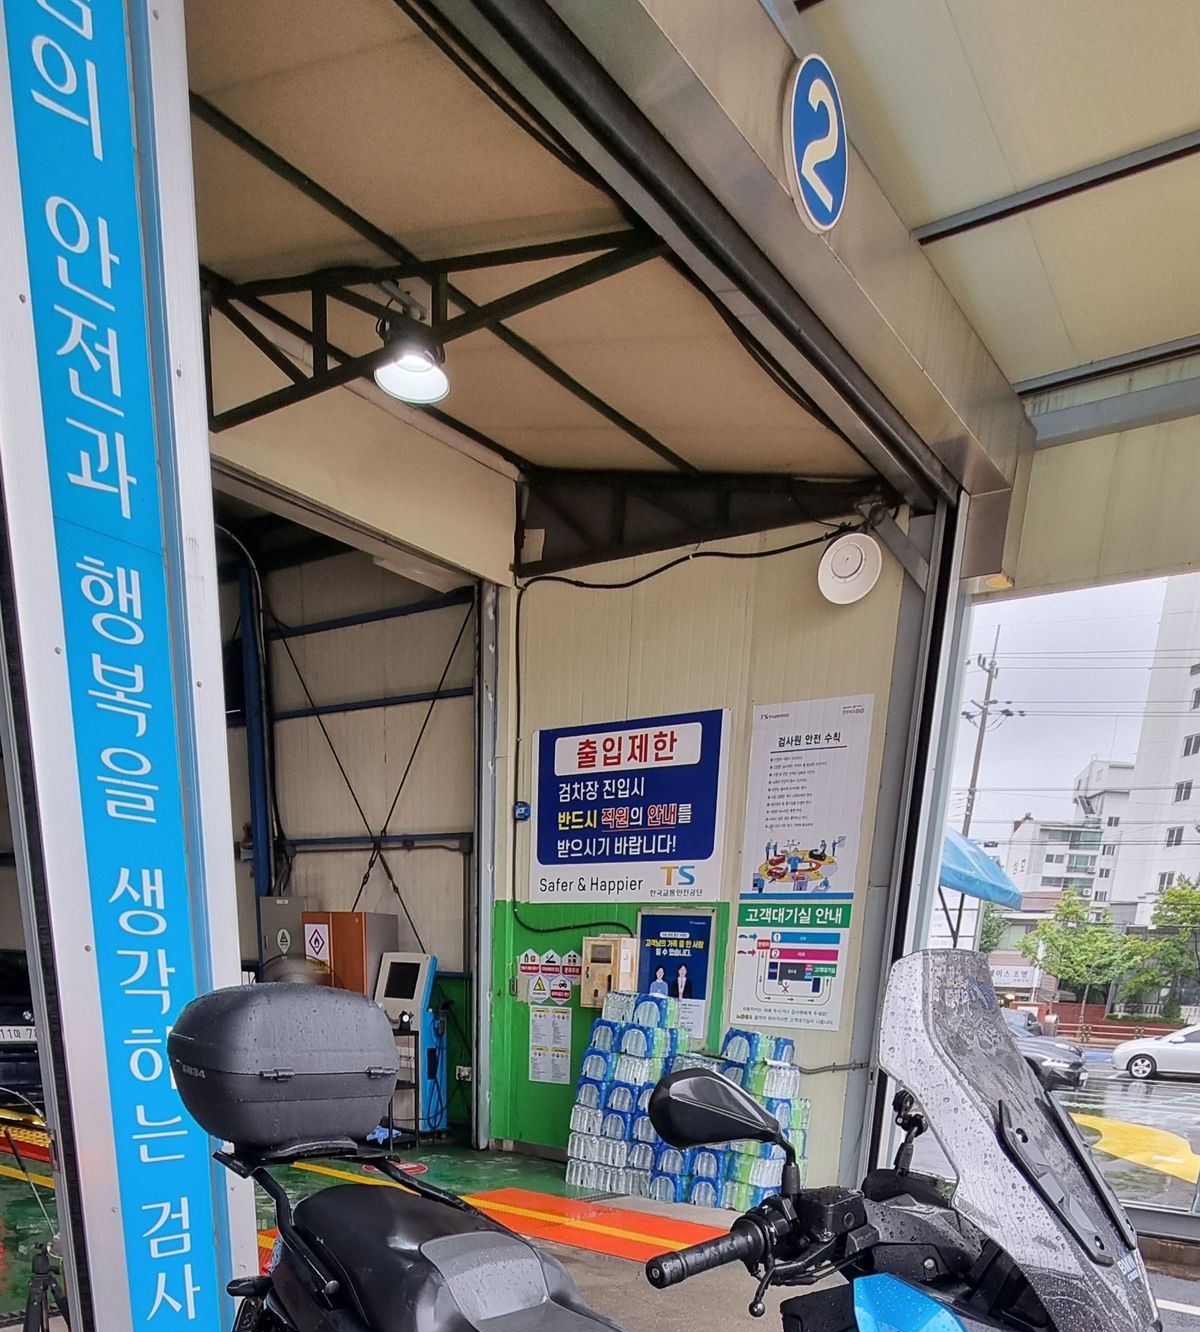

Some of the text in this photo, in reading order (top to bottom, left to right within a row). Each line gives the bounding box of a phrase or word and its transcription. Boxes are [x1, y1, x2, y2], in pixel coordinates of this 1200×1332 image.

[801, 78, 839, 214] 2
[45, 195, 137, 520] 안전과
[76, 555, 160, 824] 행복을
[576, 730, 678, 769] 출입제한
[778, 731, 841, 748] 검사원 안전 수칙
[558, 776, 645, 803] 검차장 진입시
[557, 803, 692, 831] 반드시 직원의 안내를
[556, 834, 677, 859] 받으시기 바랍니다!
[539, 876, 644, 895] Safer & Happier
[660, 865, 696, 886] TS
[649, 889, 703, 898] 한국교통안전공단
[745, 907, 843, 925] 고객대기실 안내
[108, 867, 189, 1163] 생각하는
